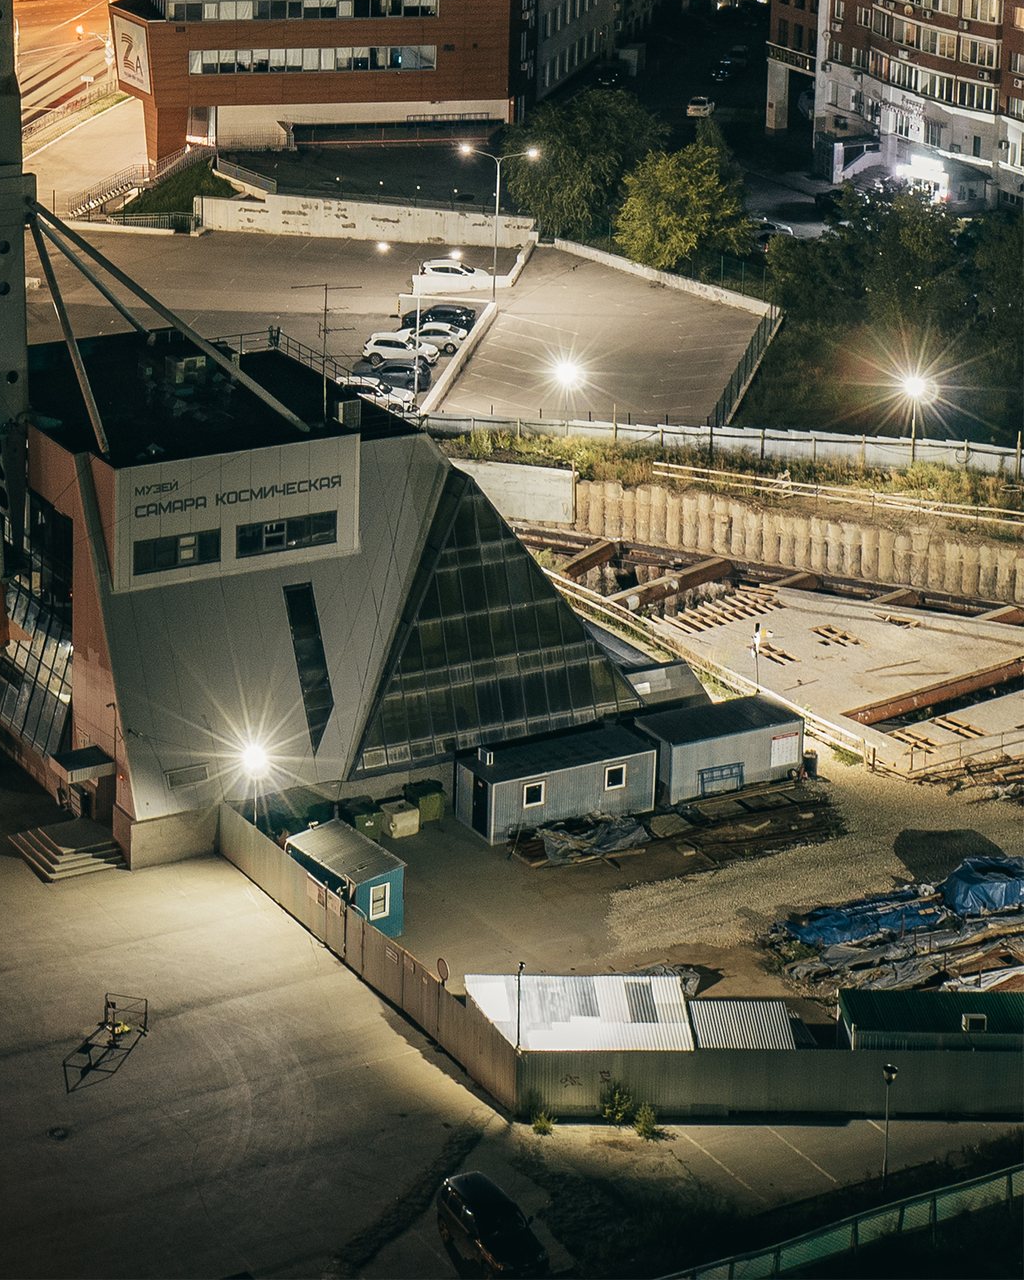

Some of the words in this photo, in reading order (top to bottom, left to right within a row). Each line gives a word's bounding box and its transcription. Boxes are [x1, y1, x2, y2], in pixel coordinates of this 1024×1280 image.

[135, 479, 179, 496] МУЗЕЙ
[135, 496, 207, 518] САМАРА
[215, 475, 342, 506] КОСМИЧЕСКАЯ
